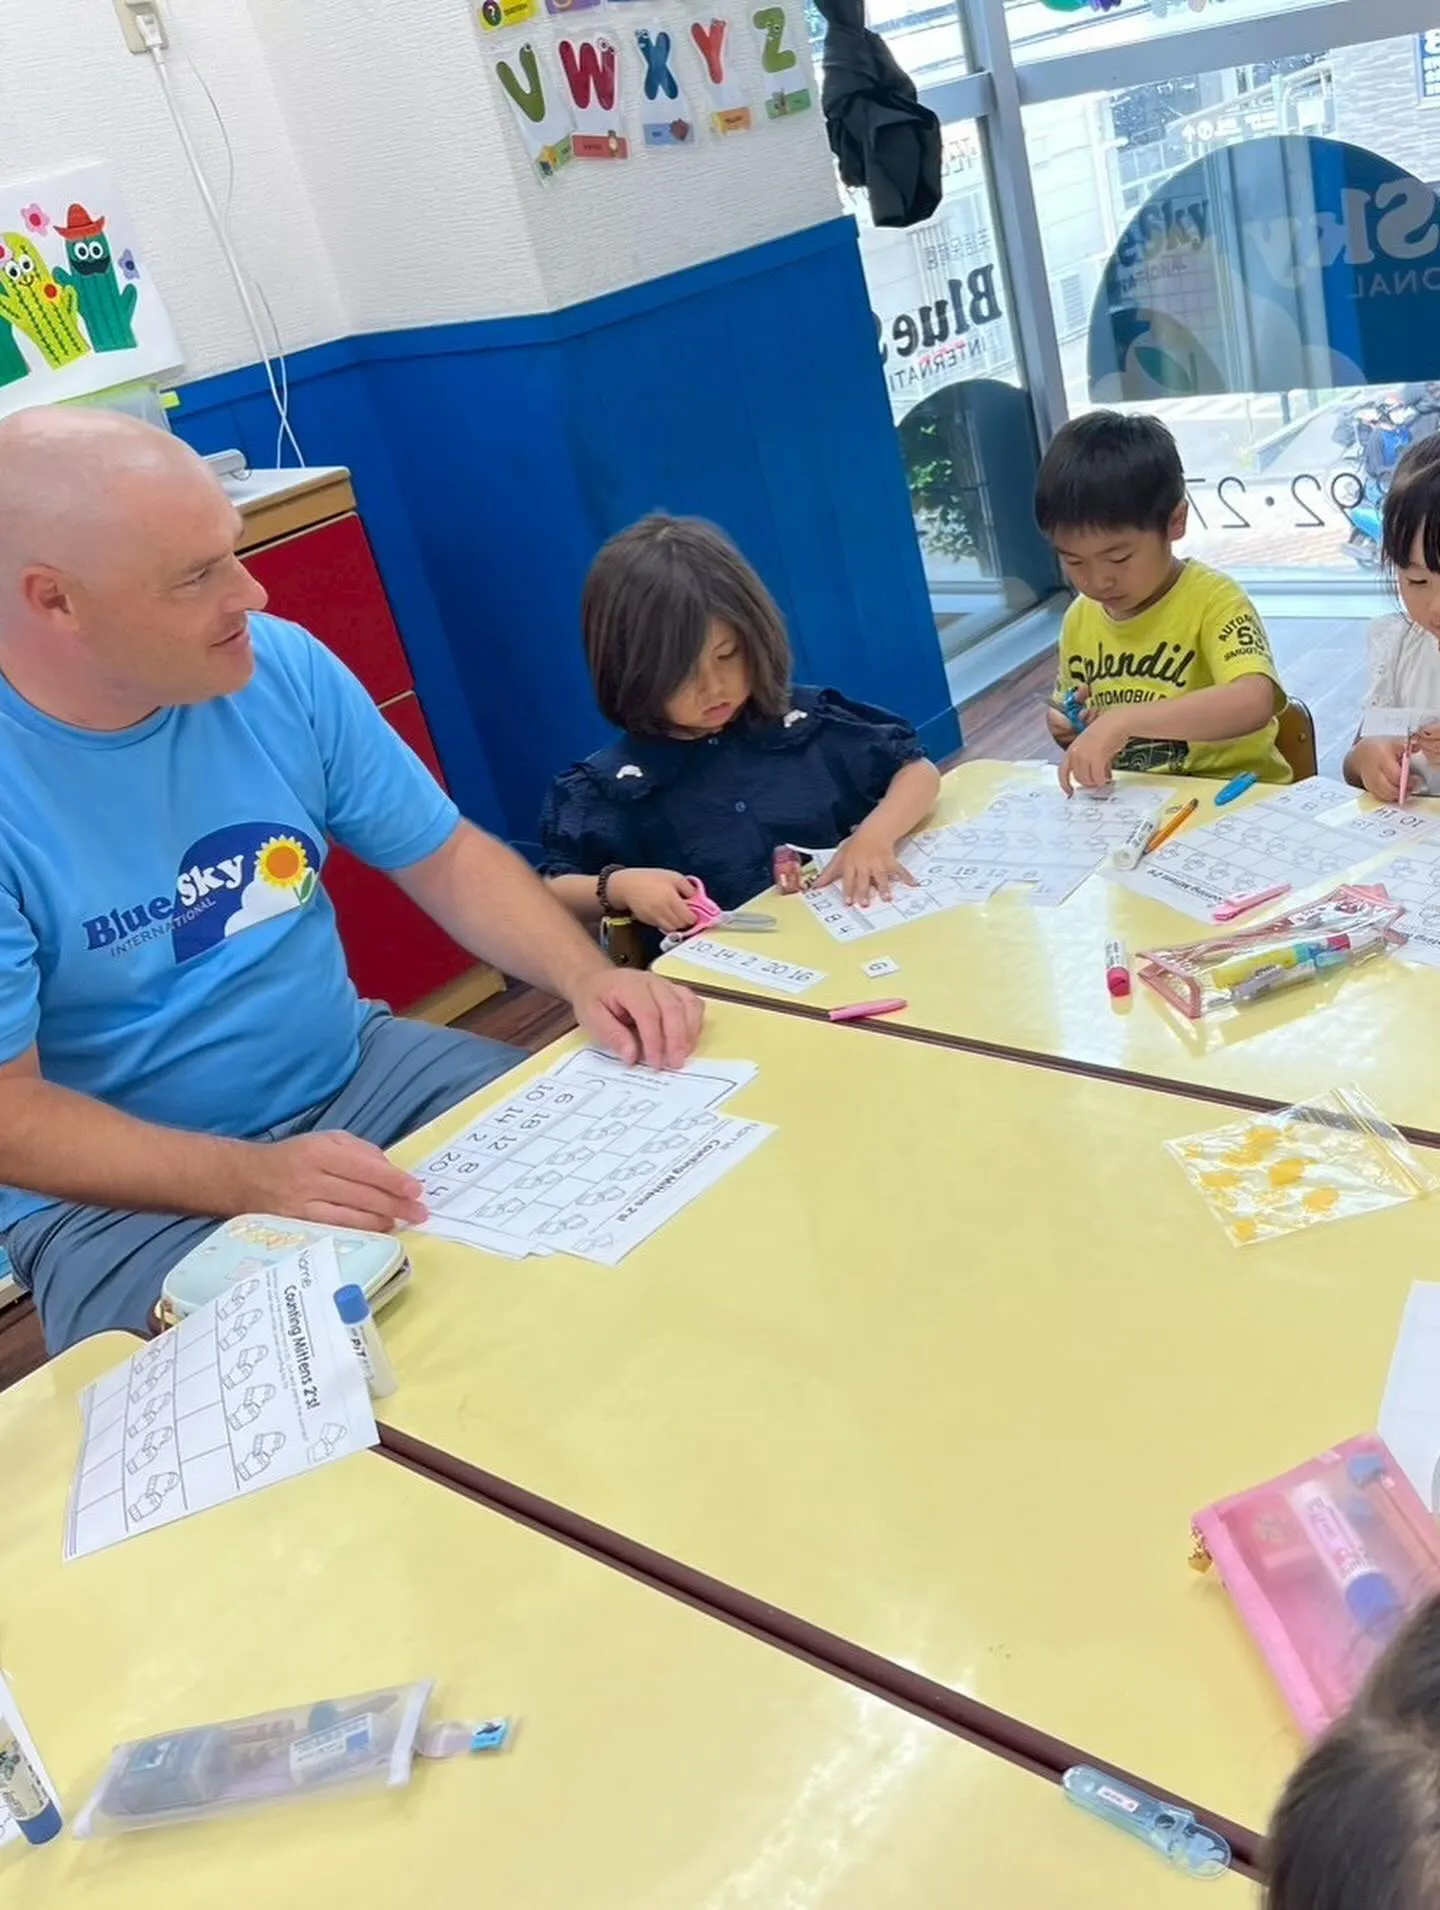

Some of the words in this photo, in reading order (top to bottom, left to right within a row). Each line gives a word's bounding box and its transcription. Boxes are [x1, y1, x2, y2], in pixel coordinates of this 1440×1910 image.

[496, 42, 546, 122] V
[558, 38, 618, 111] W
[635, 29, 679, 100] X
[691, 19, 727, 84] Y
[752, 6, 797, 73] Z
[82, 897, 174, 951] Blue
[177, 854, 244, 907] Sky
[110, 897, 217, 957] INTERNATIONAL
[526, 1084, 554, 1101] 10
[554, 1092, 574, 1104] 6
[495, 1105, 524, 1124] 14
[520, 1113, 550, 1130] 18
[466, 1132, 487, 1142] 2
[487, 1136, 517, 1151] 12
[428, 1151, 461, 1172] 20
[457, 1162, 479, 1174] 8
[283, 1283, 302, 1341] Counting
[292, 1335, 314, 1386] Mittens
